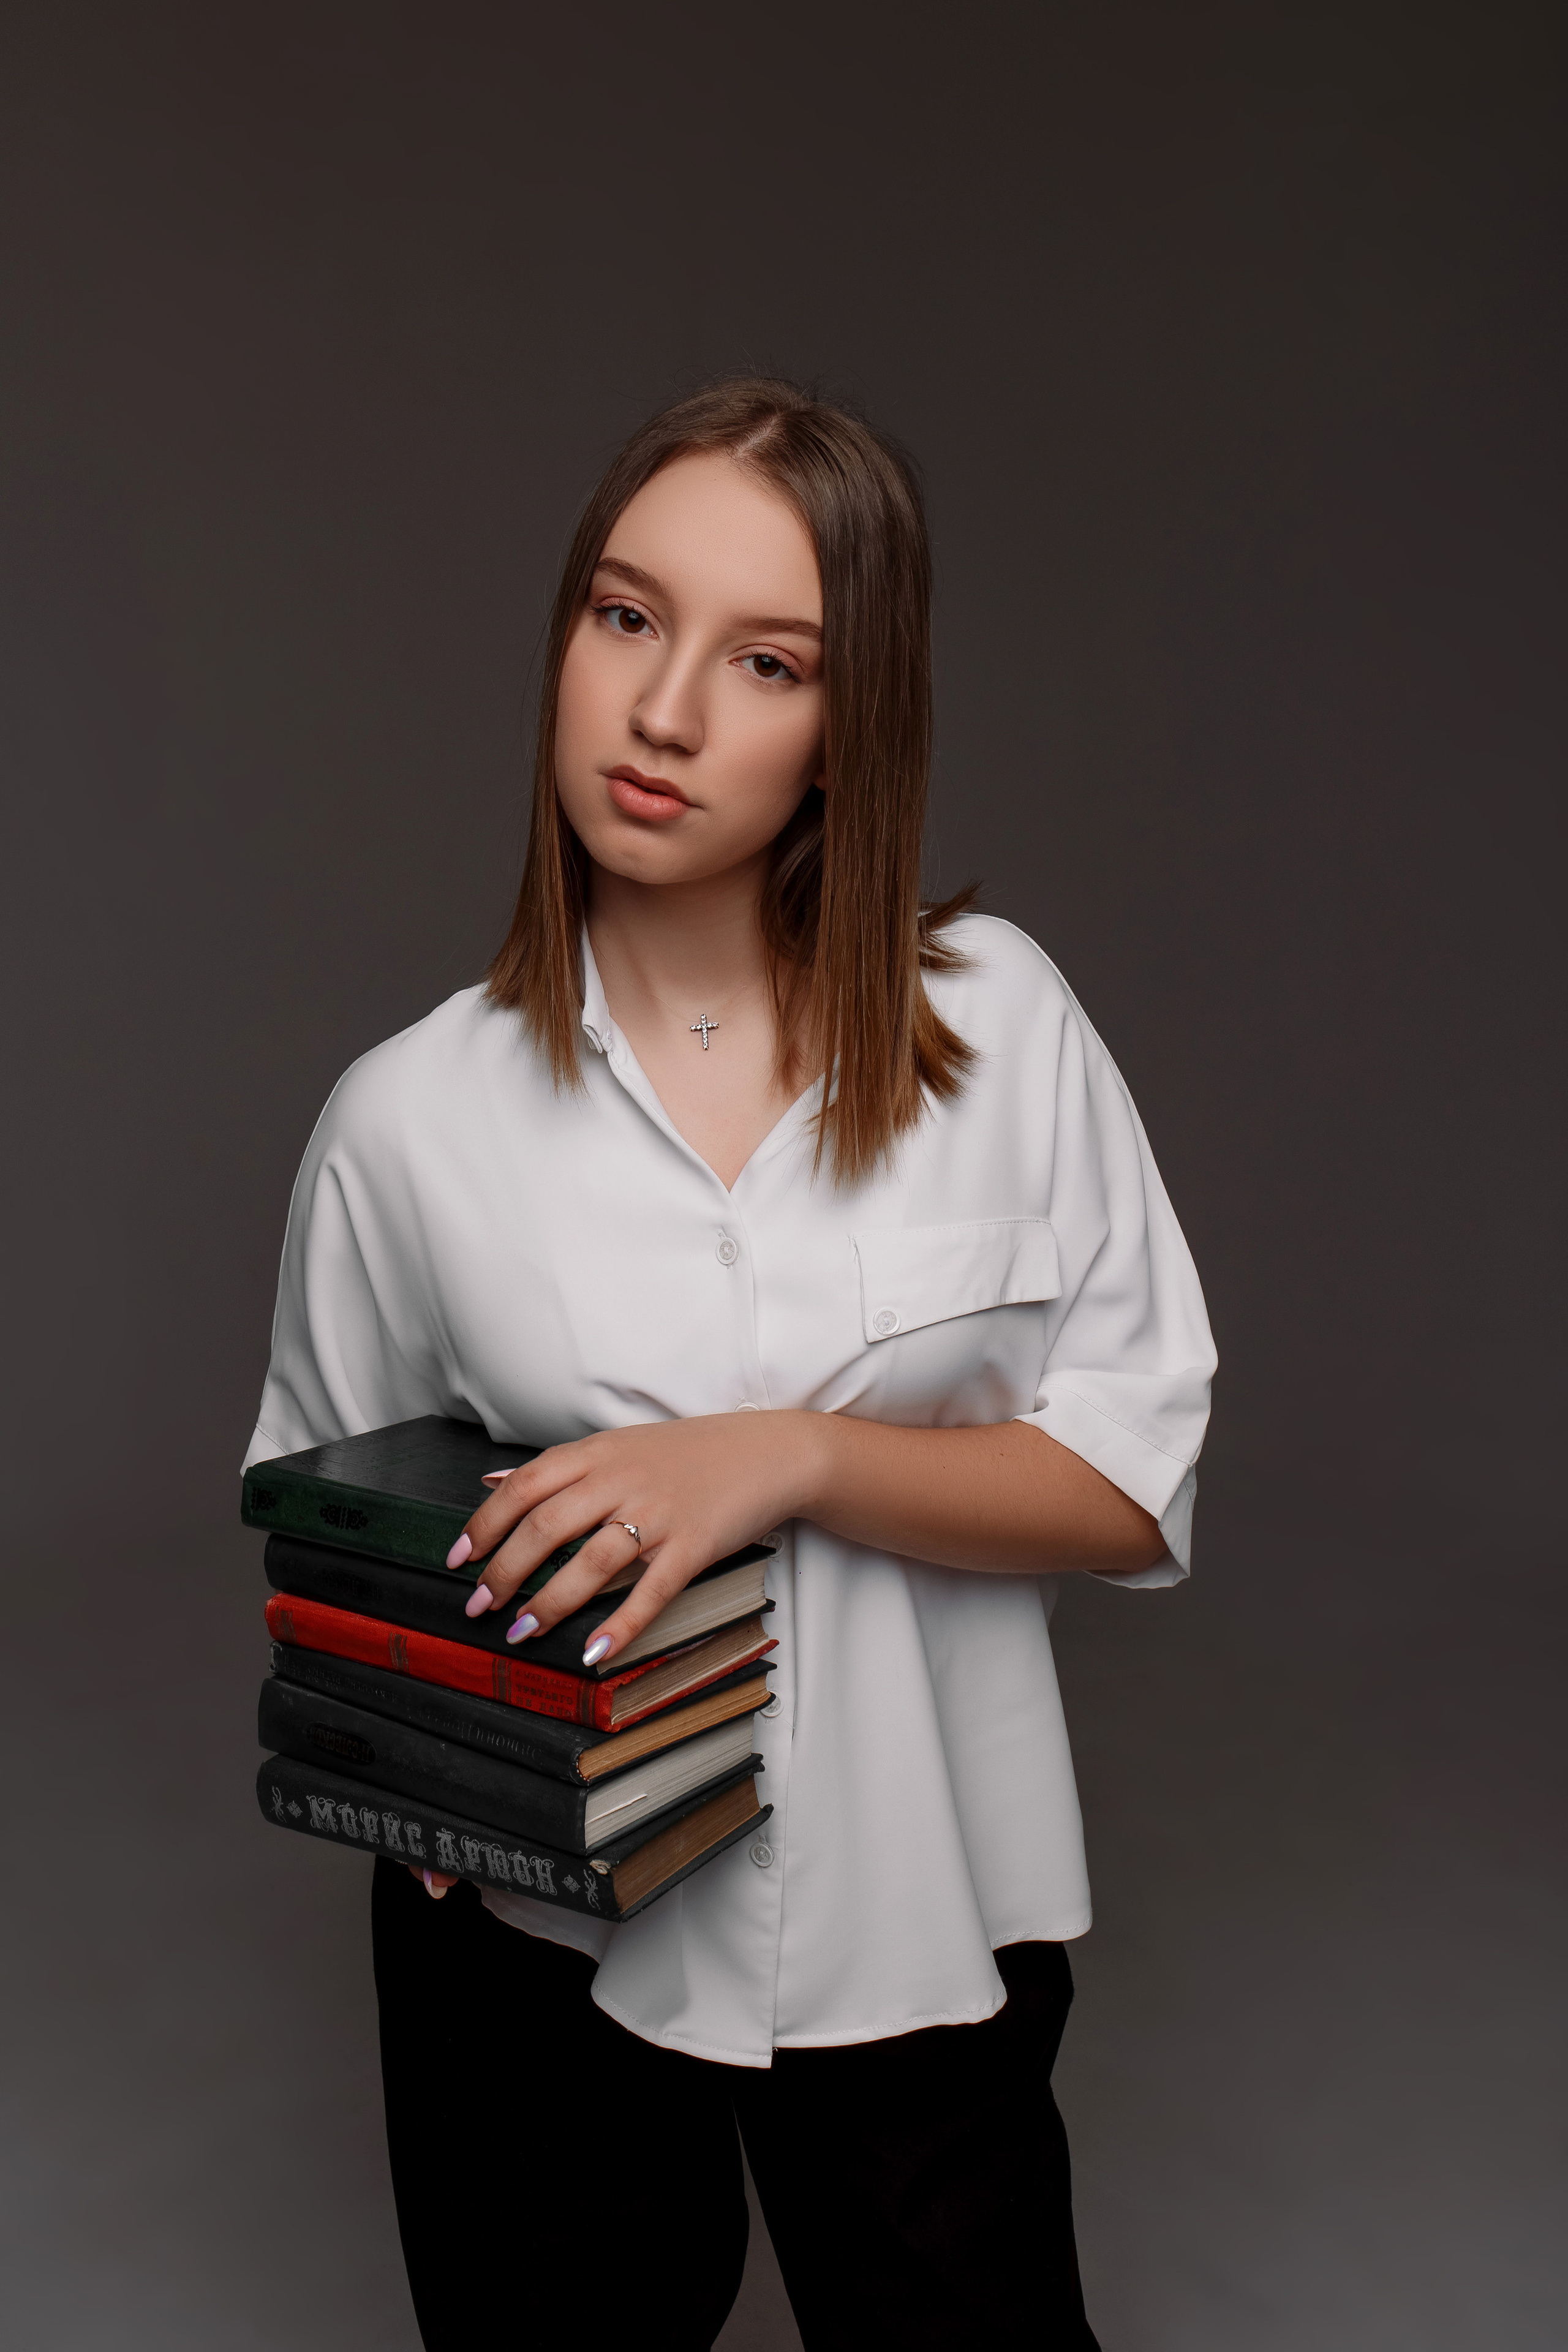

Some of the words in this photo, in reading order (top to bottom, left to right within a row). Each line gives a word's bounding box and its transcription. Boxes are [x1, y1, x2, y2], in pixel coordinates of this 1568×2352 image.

[516, 1684, 573, 1705] ТРЕТЬЕГО
[516, 1696, 532, 1707] НЕ
[538, 1702, 572, 1717] ДАНО
[306, 1795, 426, 1860] МОРИС
[435, 1827, 557, 1896] ДРЮОН
